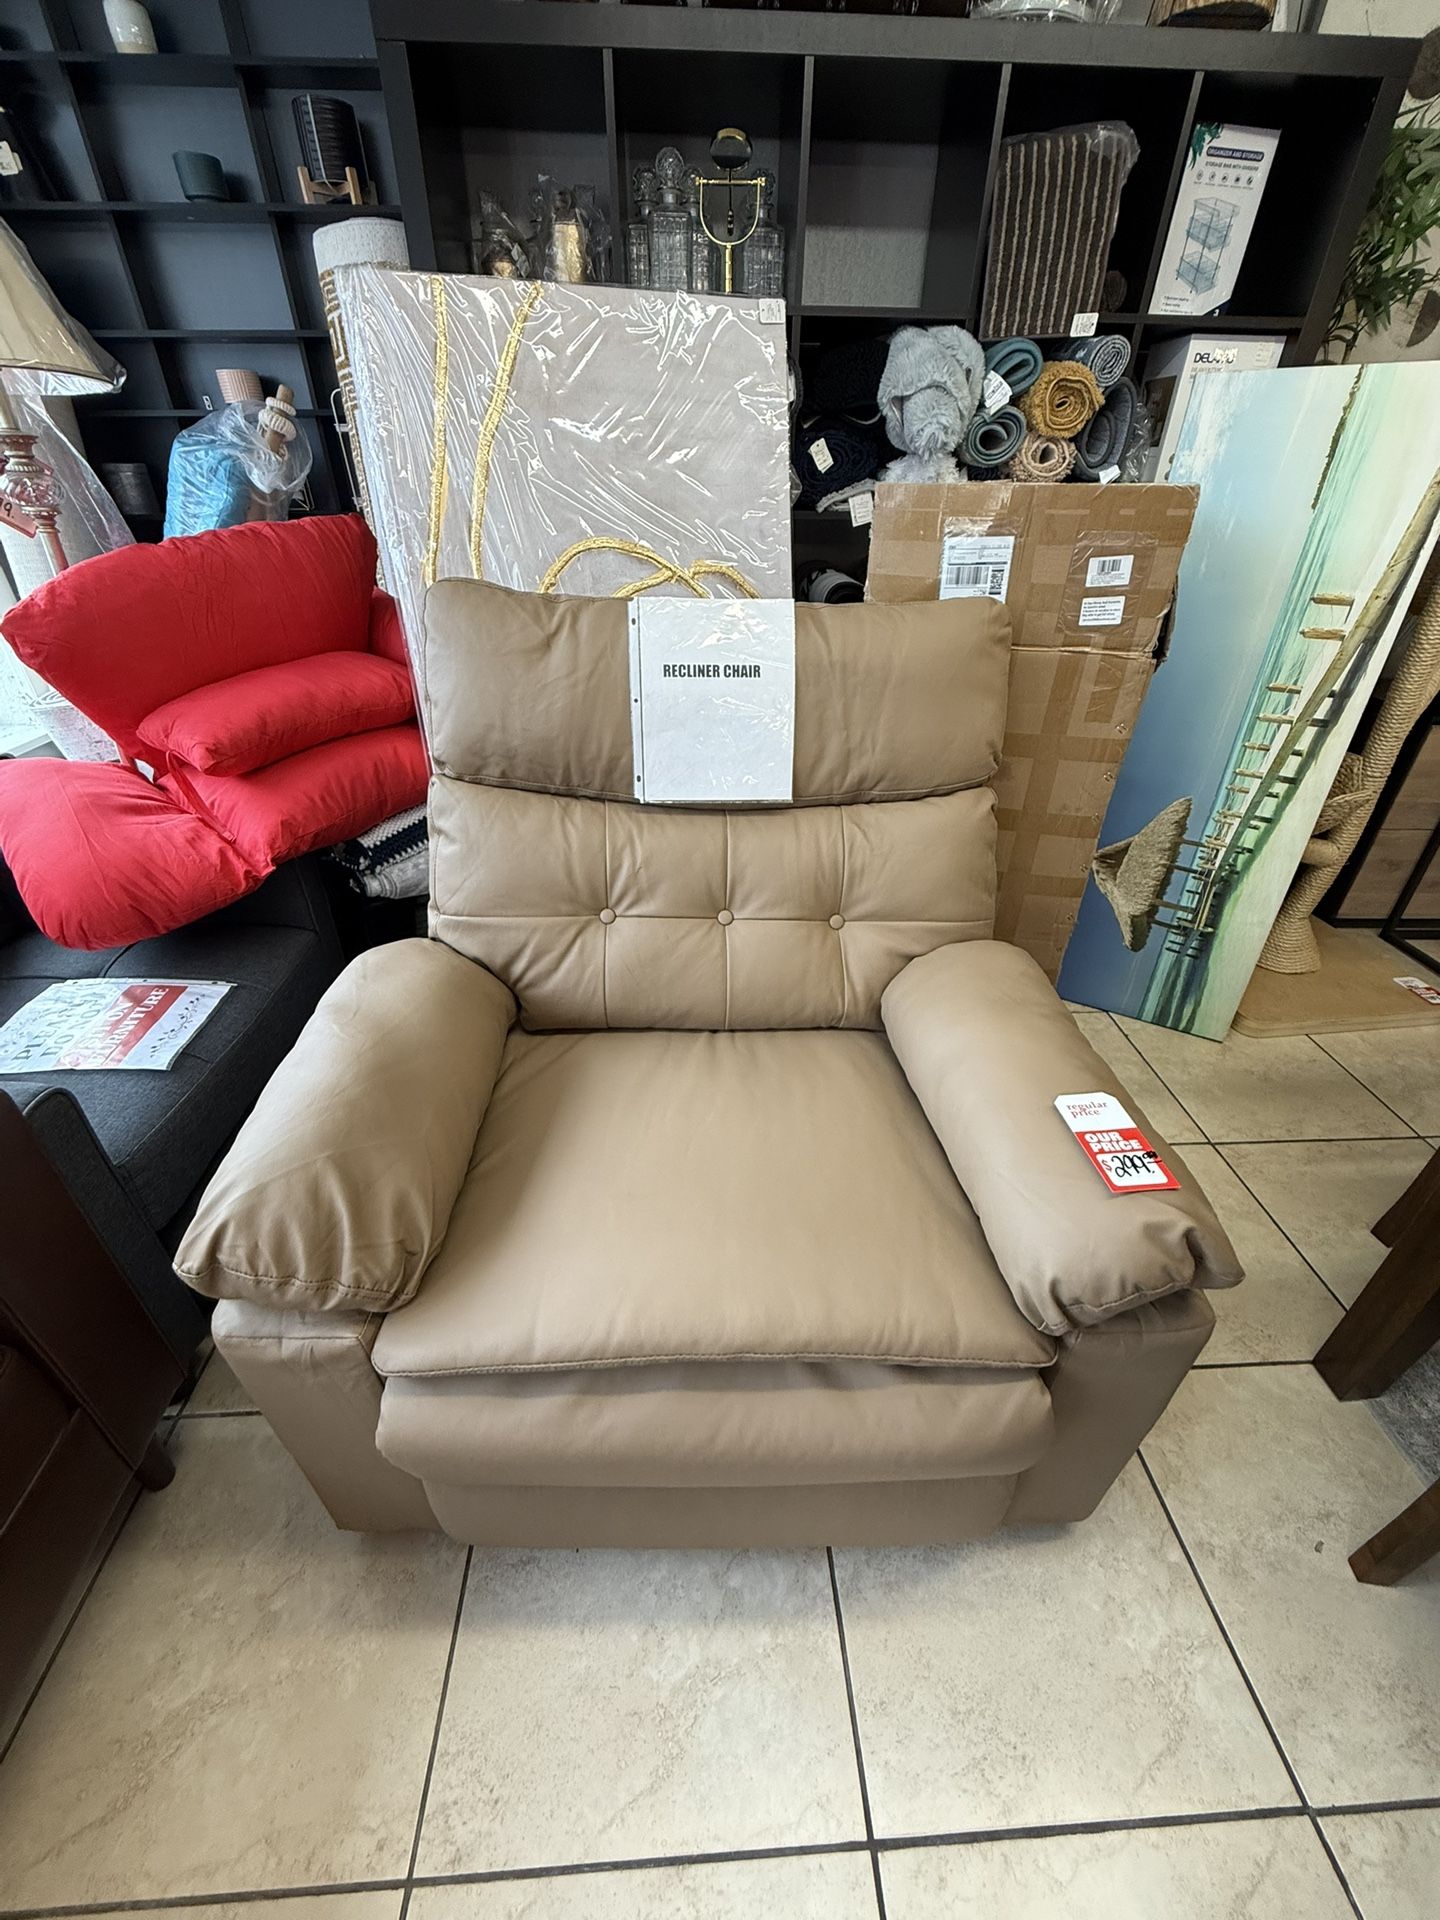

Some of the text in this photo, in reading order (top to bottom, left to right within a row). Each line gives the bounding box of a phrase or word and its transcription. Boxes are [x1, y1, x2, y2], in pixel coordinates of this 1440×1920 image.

[663, 664, 761, 678] RECLINER CHAIR
[1066, 1101, 1108, 1112] regular
[1070, 1108, 1100, 1119] price
[1084, 1132, 1123, 1142] OUR
[1088, 1139, 1143, 1152] PRICE
